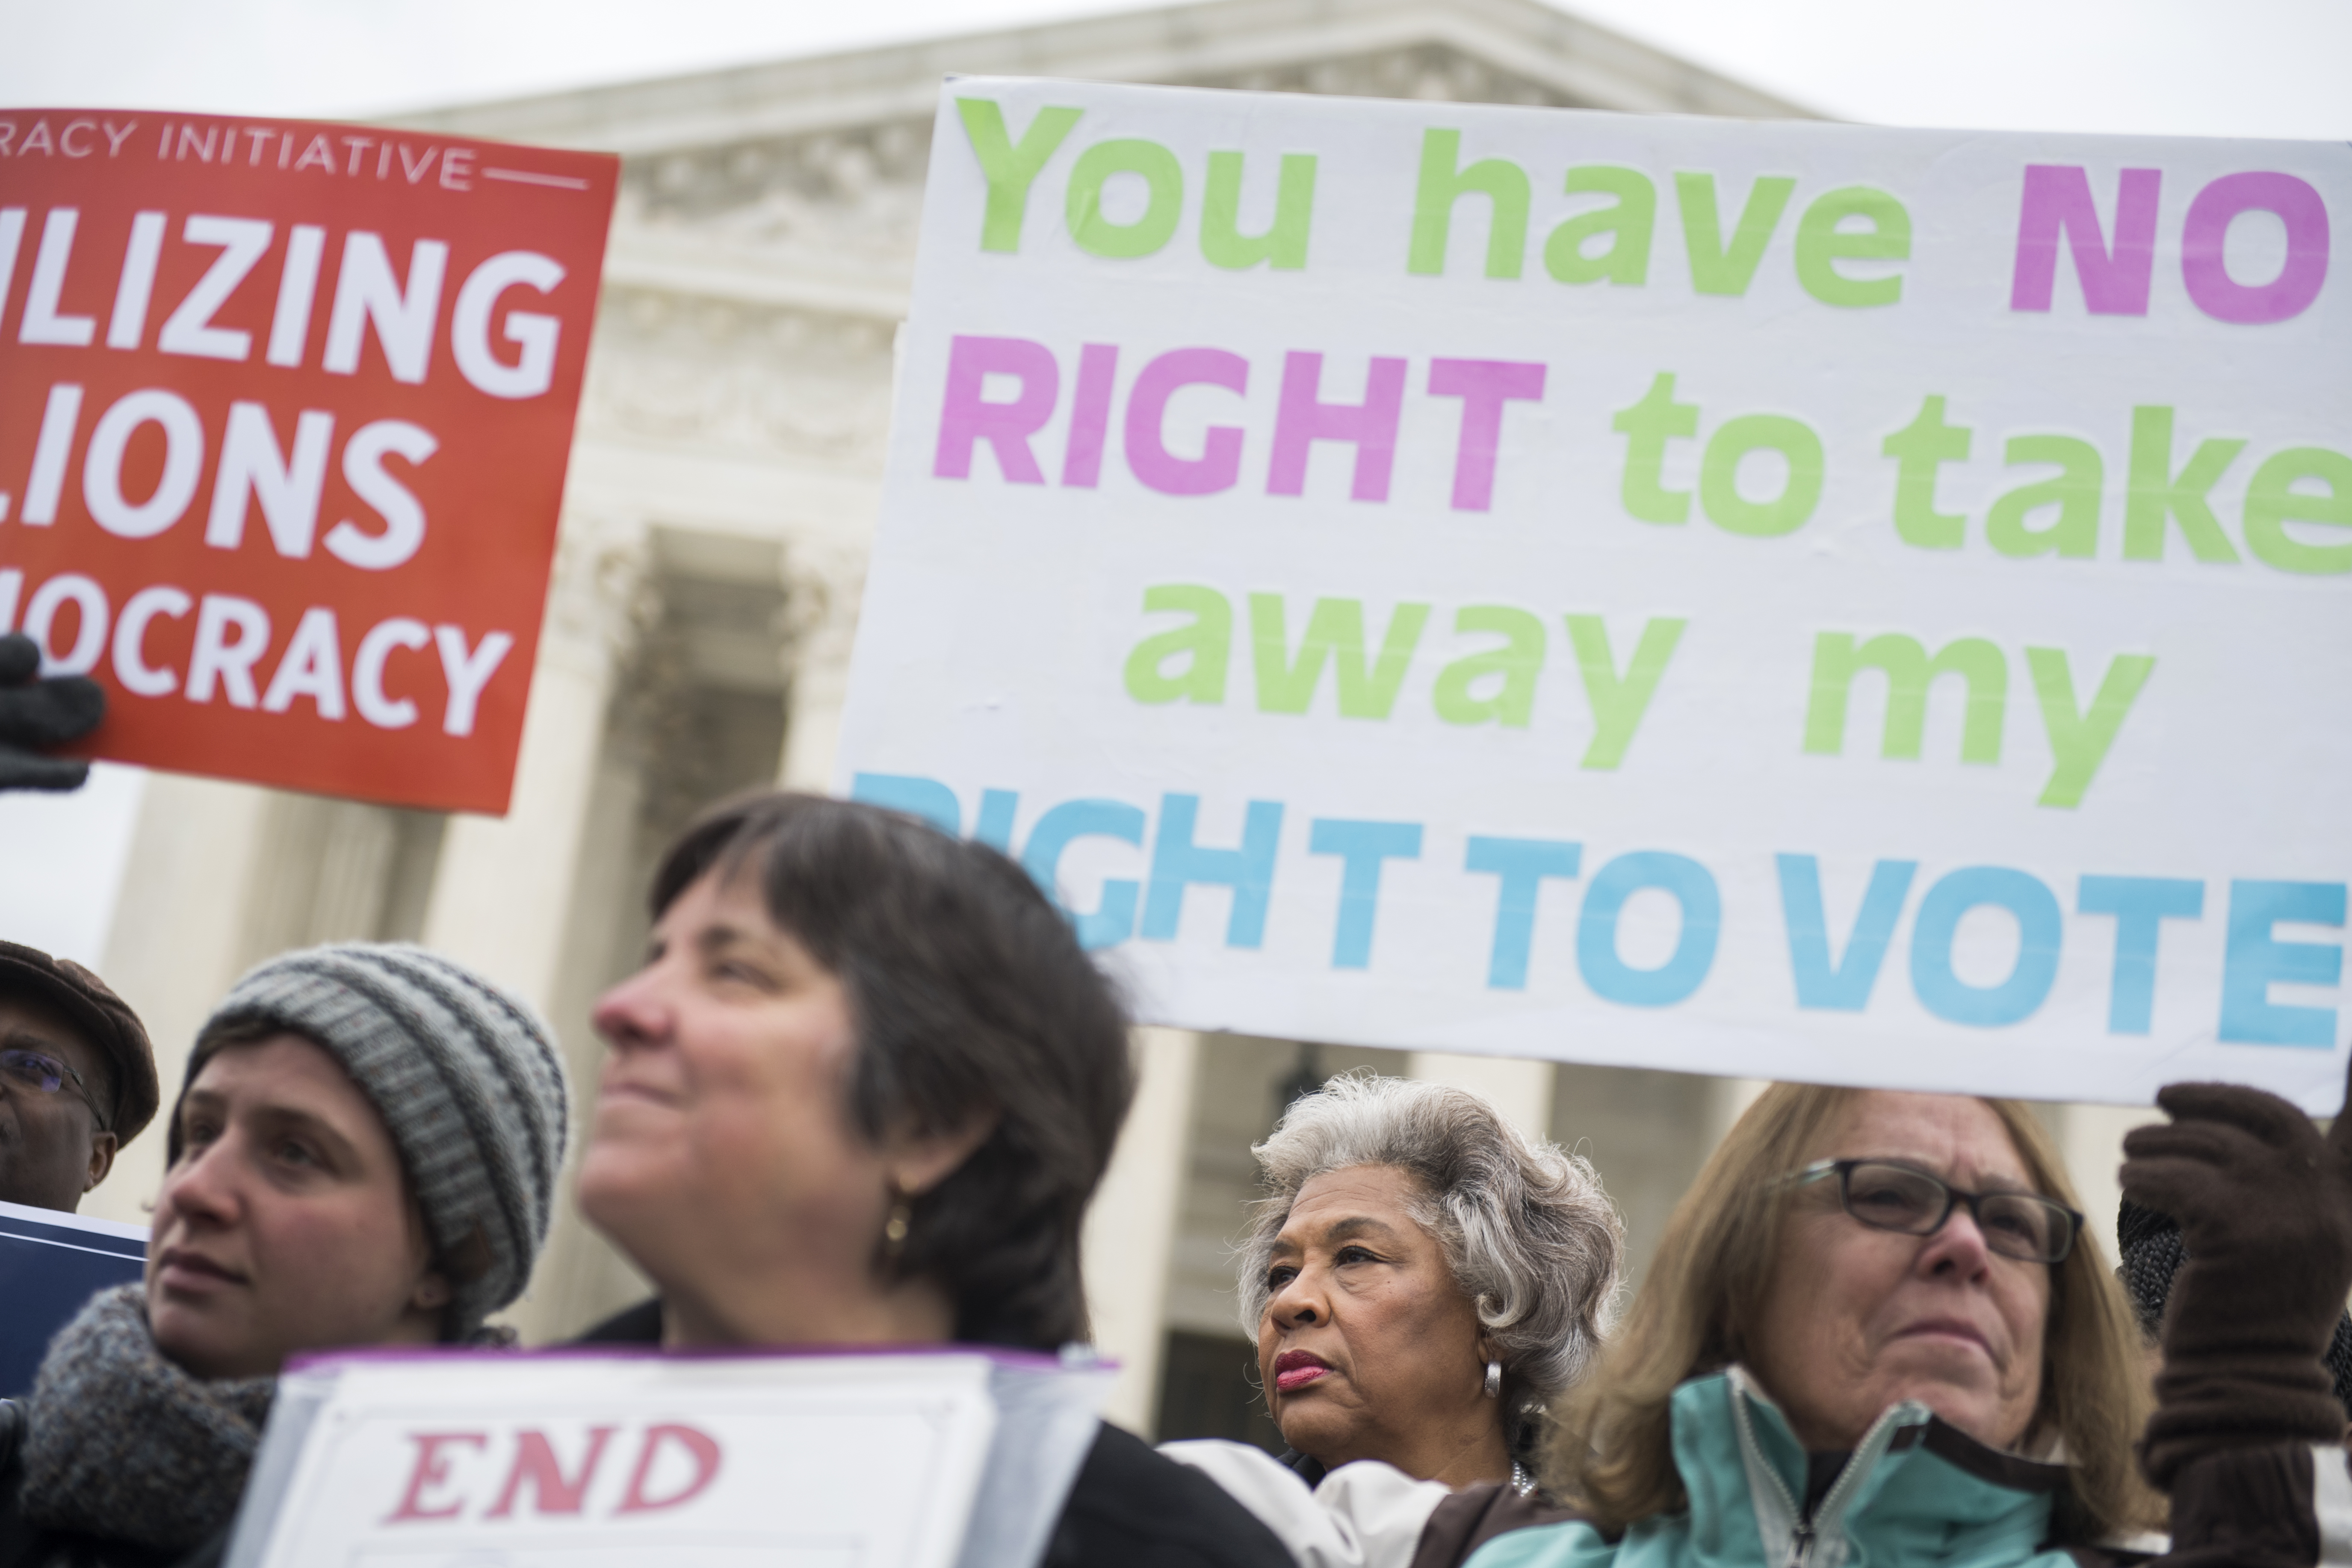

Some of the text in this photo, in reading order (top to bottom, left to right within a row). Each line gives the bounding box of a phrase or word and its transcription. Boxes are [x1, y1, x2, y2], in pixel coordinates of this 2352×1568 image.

[157, 121, 477, 192] INITIATIVE
[955, 97, 2330, 325] You have NO
[0, 383, 440, 570] IONS
[933, 334, 2352, 573] RIGHT to take
[0, 567, 514, 737] OCRACY
[1124, 584, 2157, 808] away my
[1463, 834, 1723, 1009] TO
[1774, 852, 2350, 1051] VOTE
[378, 1422, 724, 1526] END
